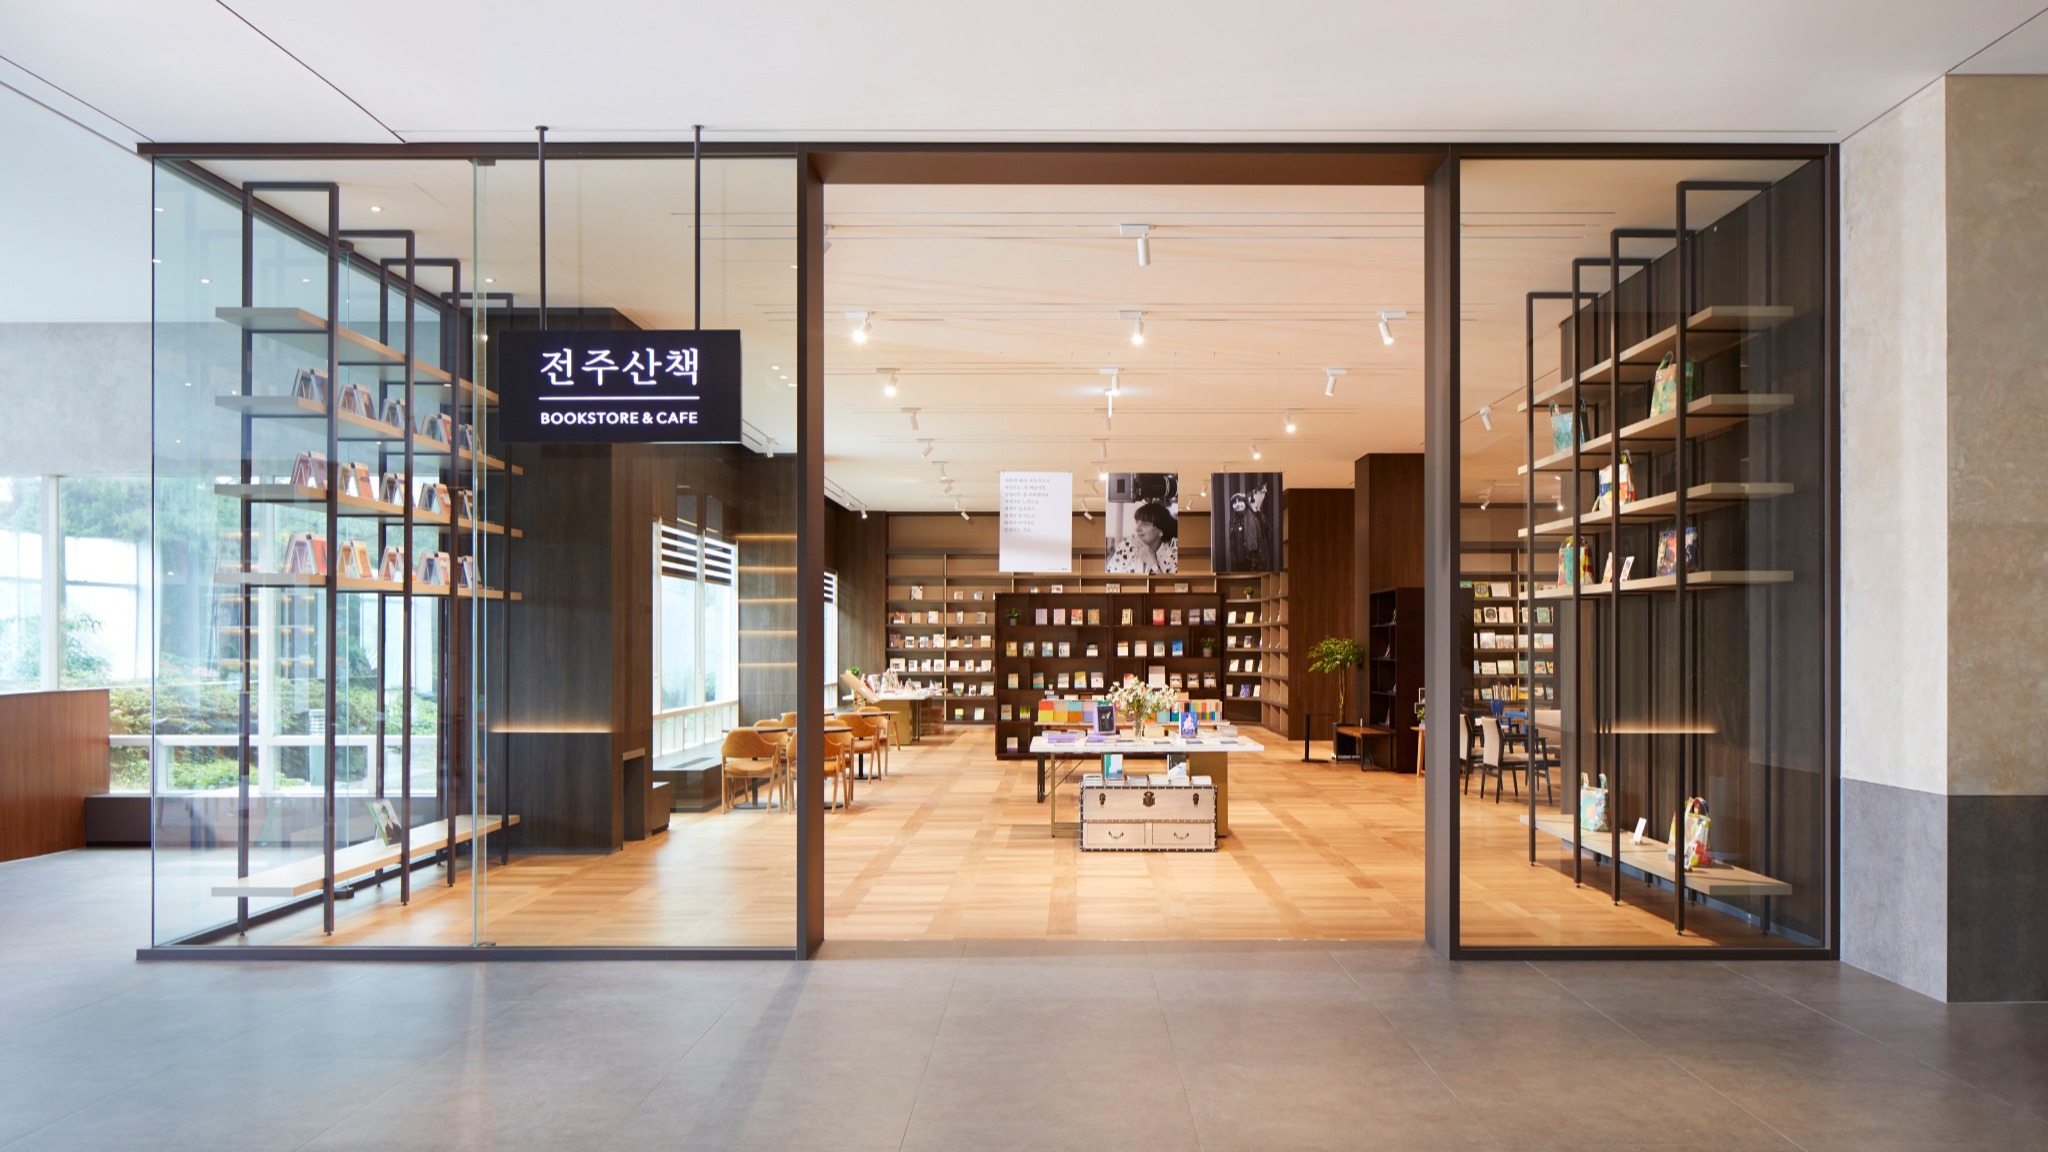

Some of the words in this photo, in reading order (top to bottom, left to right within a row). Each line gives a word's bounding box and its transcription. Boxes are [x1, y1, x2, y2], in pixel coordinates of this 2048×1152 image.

[541, 348, 698, 386] 전주산책
[541, 412, 639, 424] BOOKSTORE
[642, 412, 653, 424] &
[656, 412, 697, 424] CAFE
